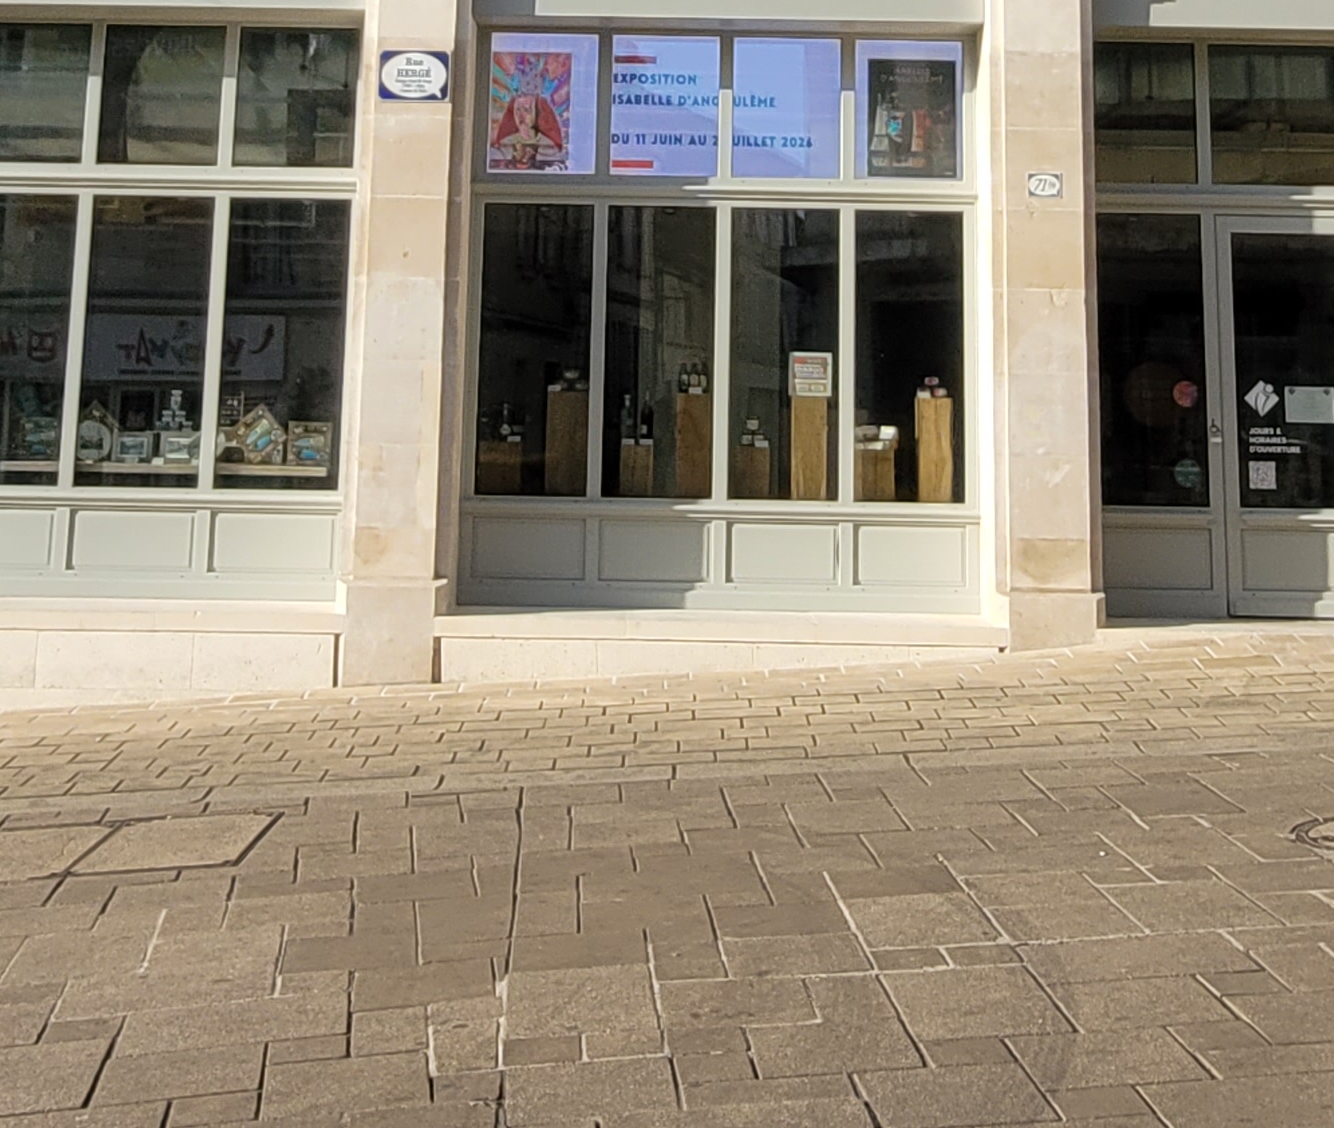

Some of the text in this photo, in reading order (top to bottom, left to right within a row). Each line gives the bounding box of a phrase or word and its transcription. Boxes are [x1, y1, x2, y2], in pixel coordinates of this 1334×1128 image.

[405, 57, 424, 66] Rue
[397, 67, 432, 78] HERGÉ
[613, 73, 697, 85] EXPOSITION
[613, 93, 673, 106] ISABELLE
[611, 133, 630, 145] DU
[635, 133, 647, 145] 11
[651, 133, 682, 146] JUIN
[688, 134, 707, 146] AU
[732, 135, 776, 148] UILLET
[781, 136, 813, 148] 2026
